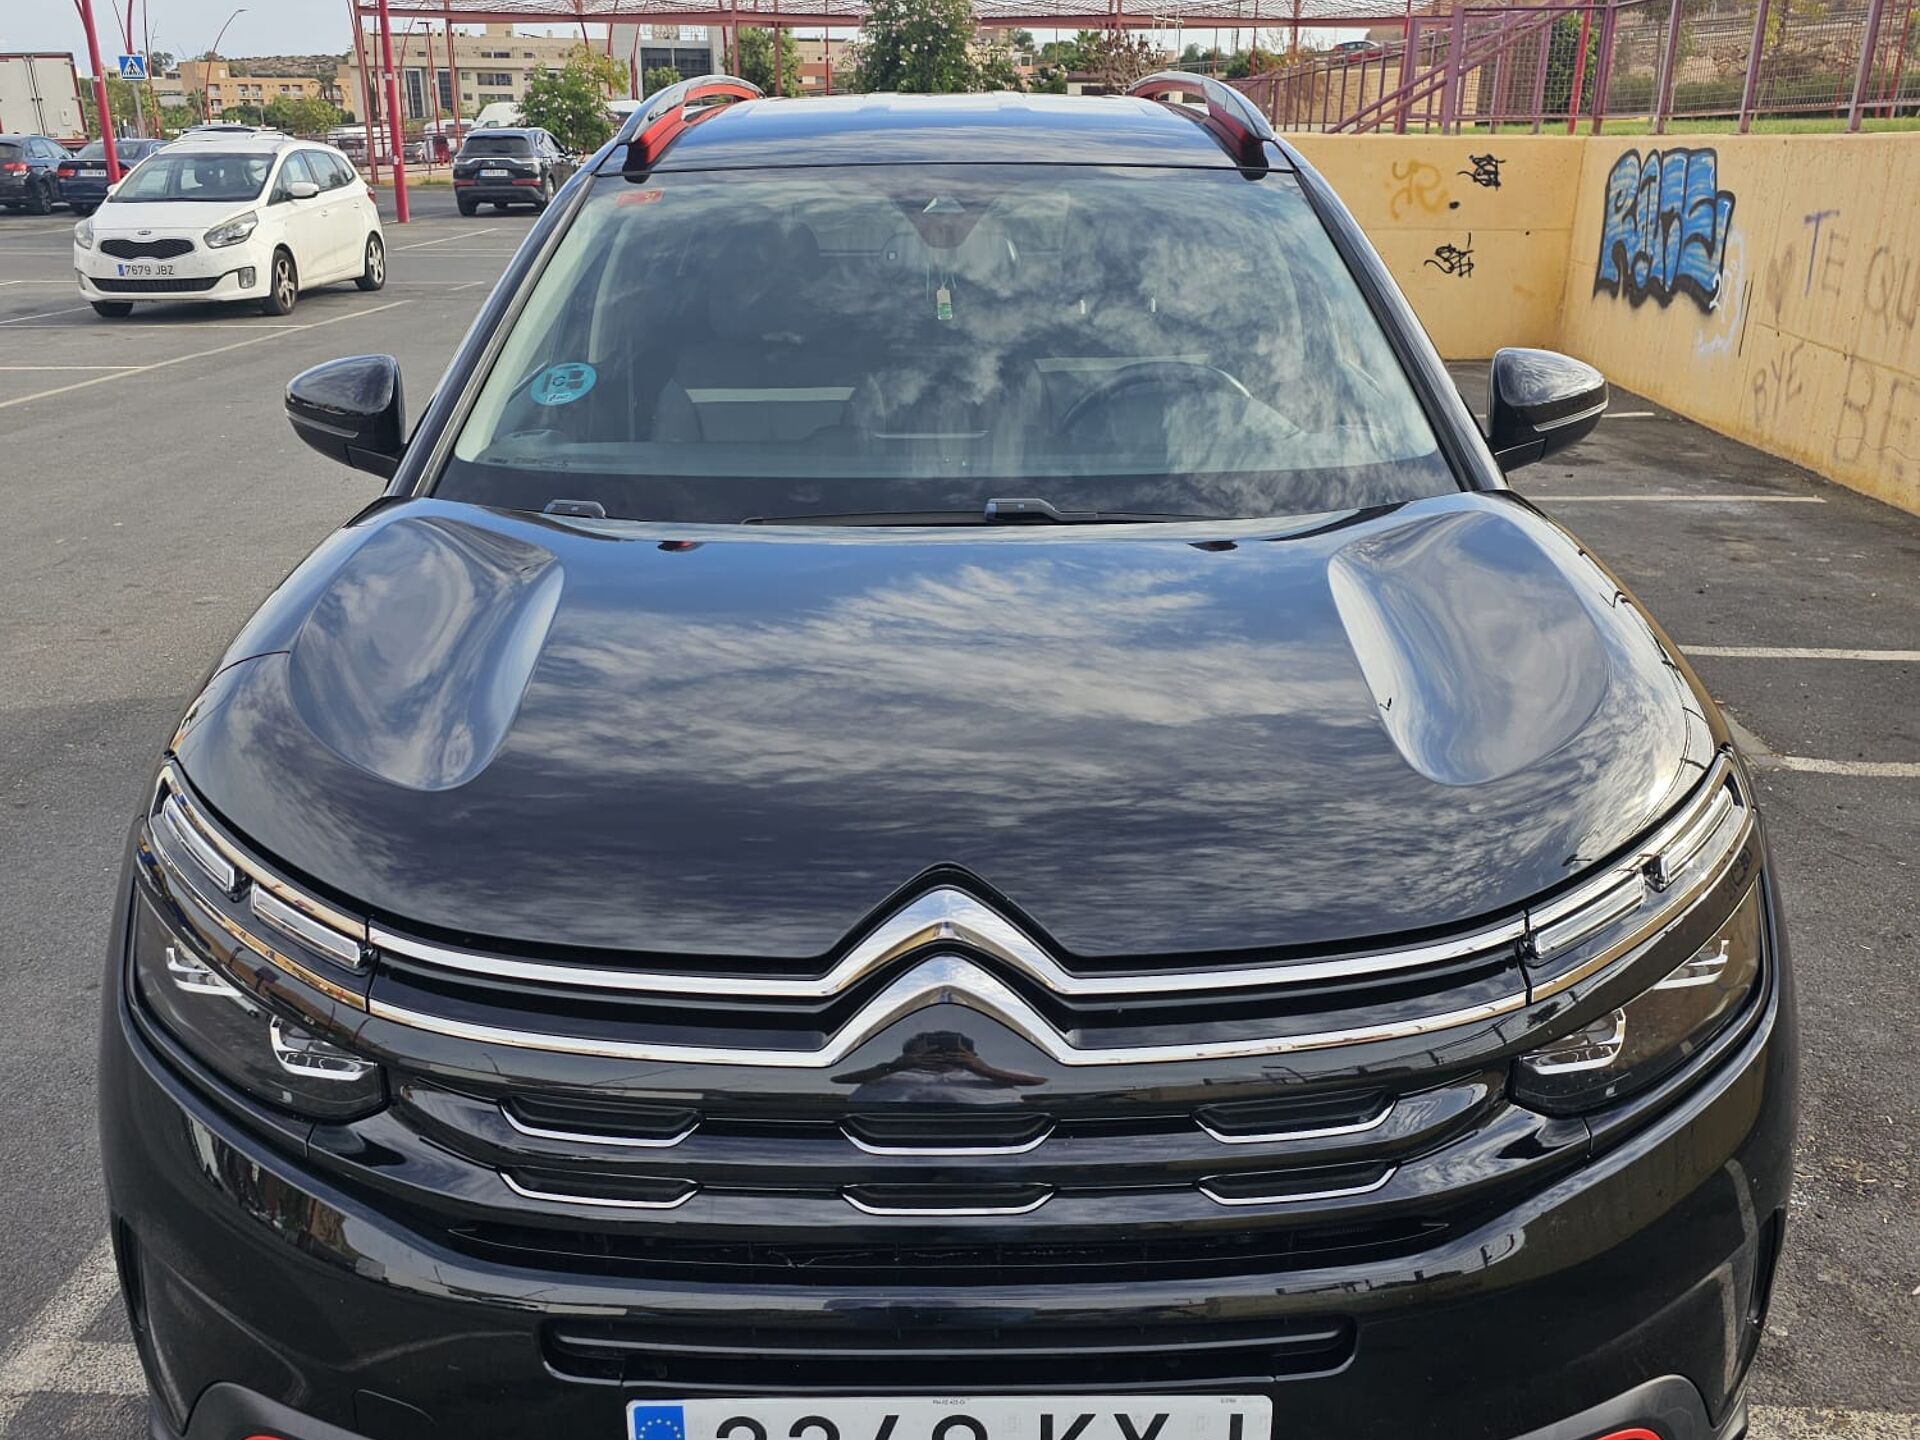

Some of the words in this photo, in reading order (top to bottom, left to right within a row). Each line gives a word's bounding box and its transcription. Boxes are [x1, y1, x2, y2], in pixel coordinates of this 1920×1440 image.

[125, 265, 151, 276] 7679
[155, 265, 175, 276] JBZ
[1803, 208, 1850, 298] TE
[1752, 342, 1805, 428] BYE
